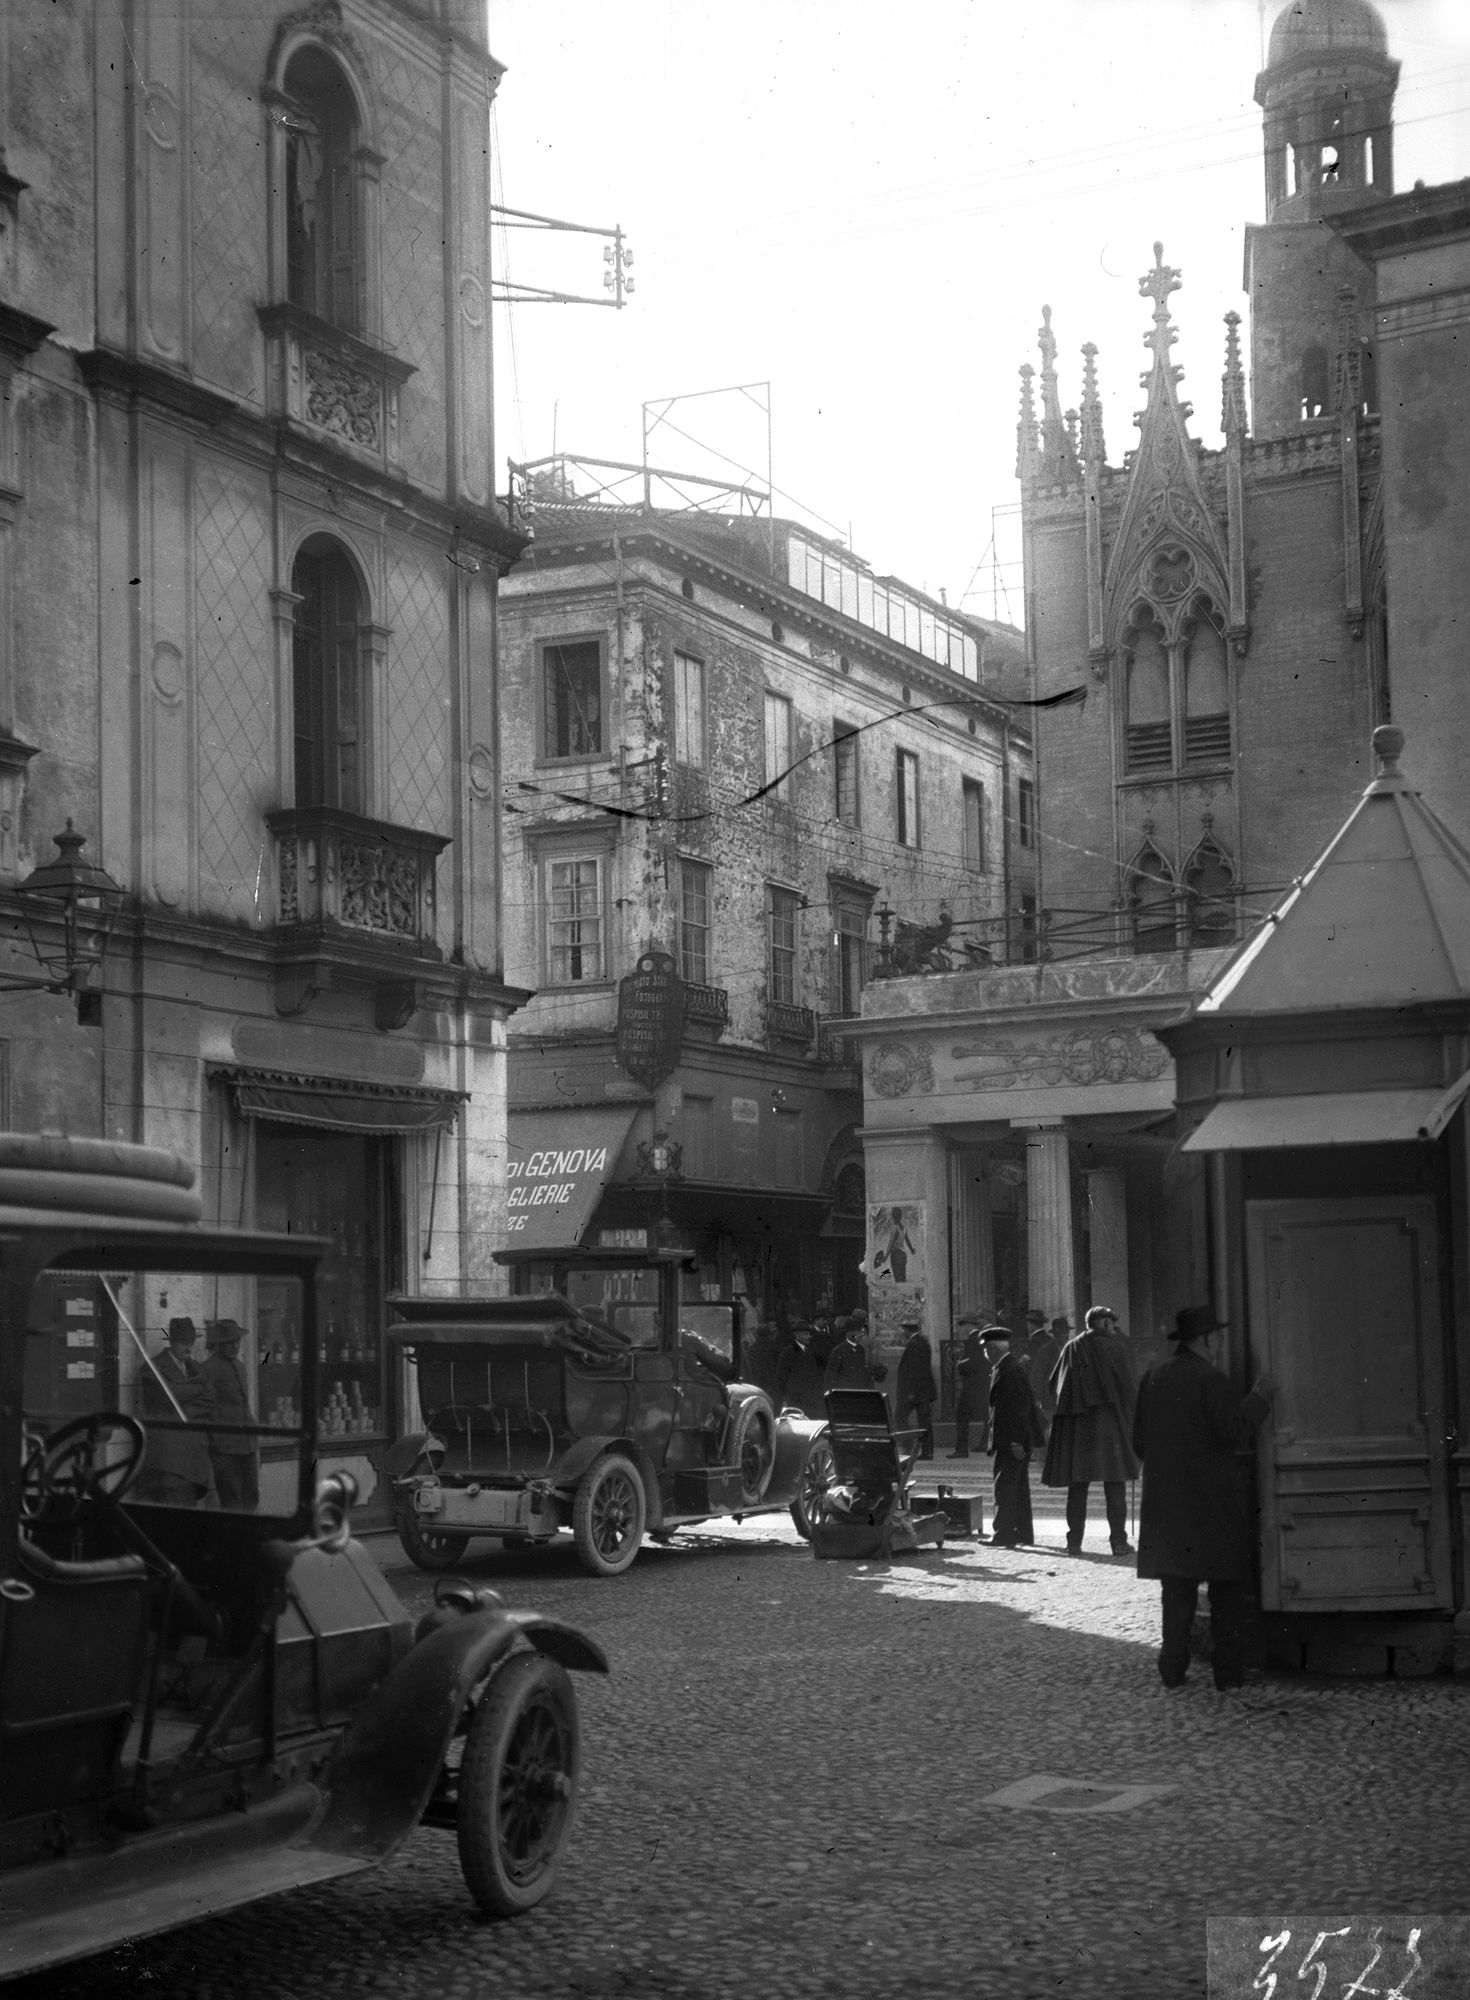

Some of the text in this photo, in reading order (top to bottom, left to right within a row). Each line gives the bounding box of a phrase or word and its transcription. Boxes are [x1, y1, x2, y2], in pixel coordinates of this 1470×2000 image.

[507, 1148, 607, 1178] DI GENOVA
[507, 1183, 576, 1207] GLIERIE
